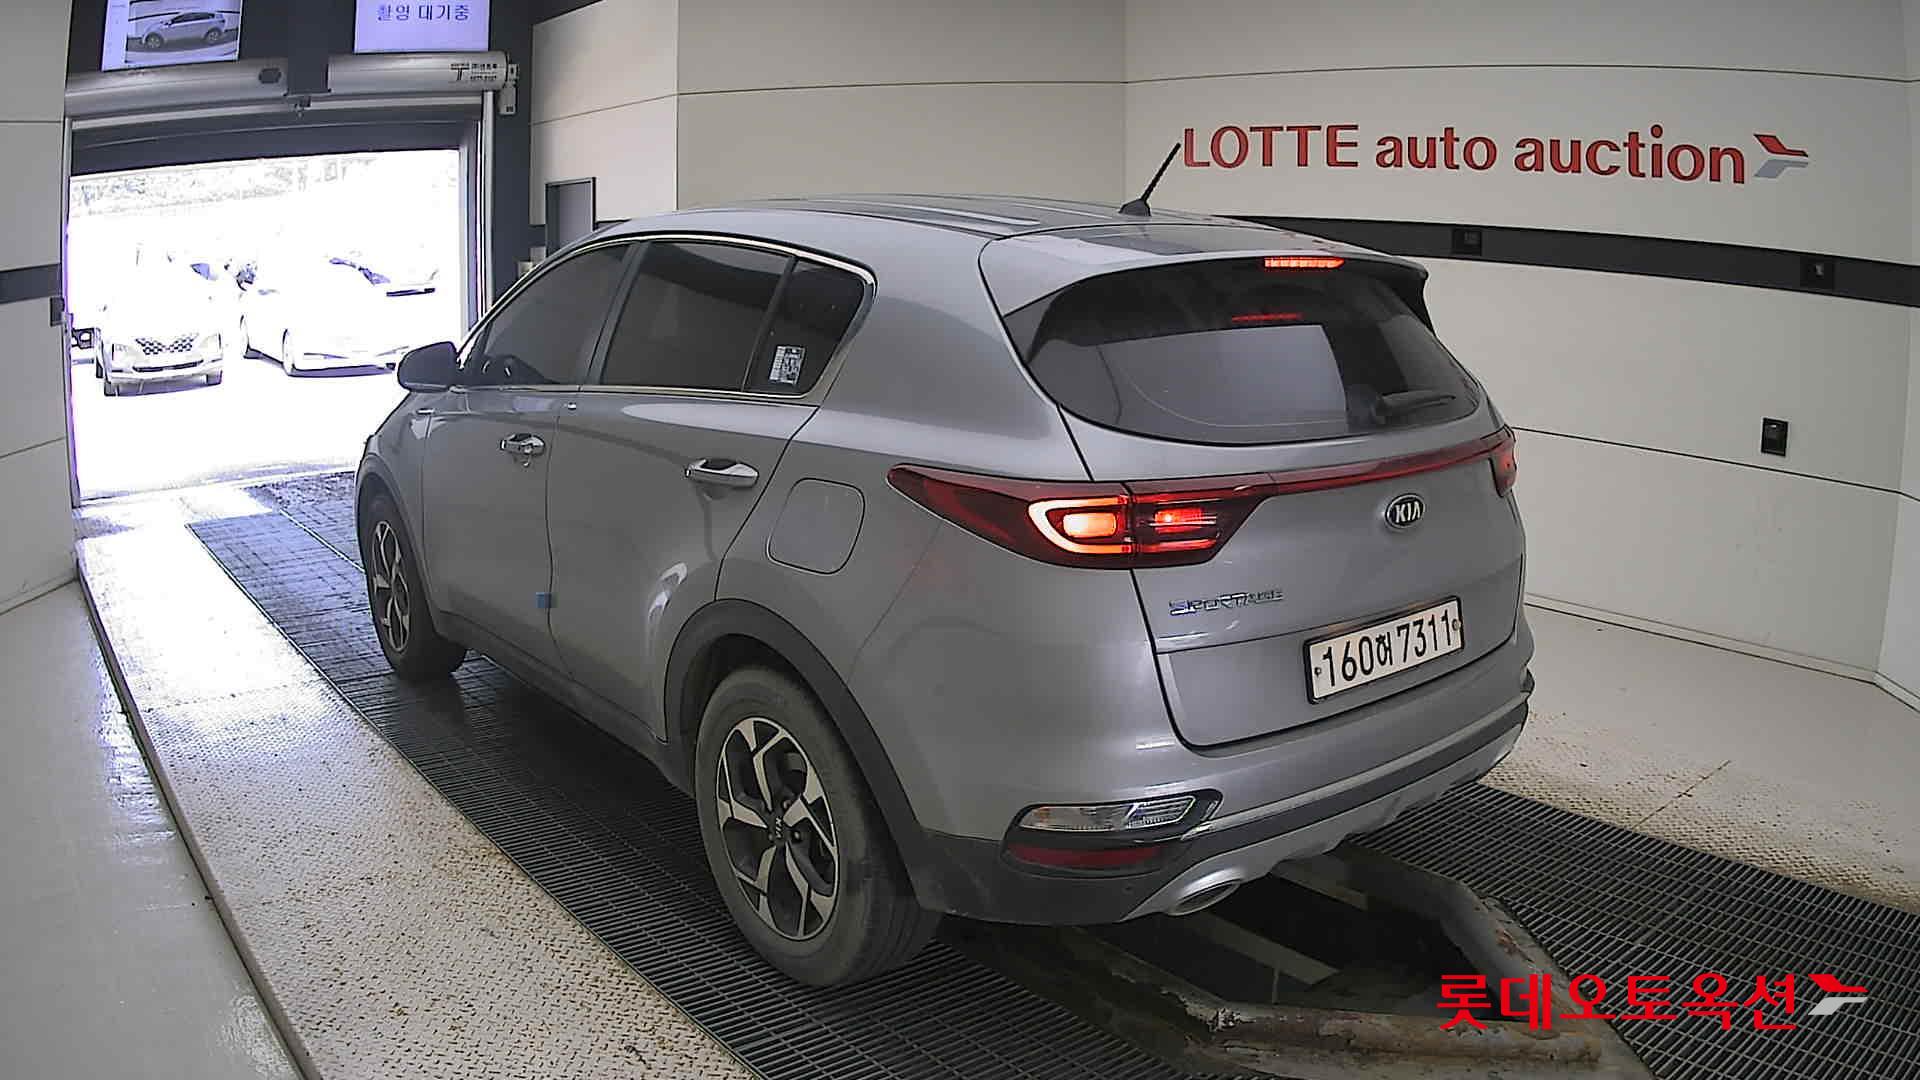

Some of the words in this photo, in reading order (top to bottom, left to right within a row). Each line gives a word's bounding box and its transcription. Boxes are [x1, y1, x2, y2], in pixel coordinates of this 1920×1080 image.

[418, 4, 469, 21] 대기중
[1183, 124, 1359, 168] LOTTE
[1375, 127, 1498, 170] auto
[1514, 125, 1746, 184] auction
[1395, 501, 1421, 523] KIA
